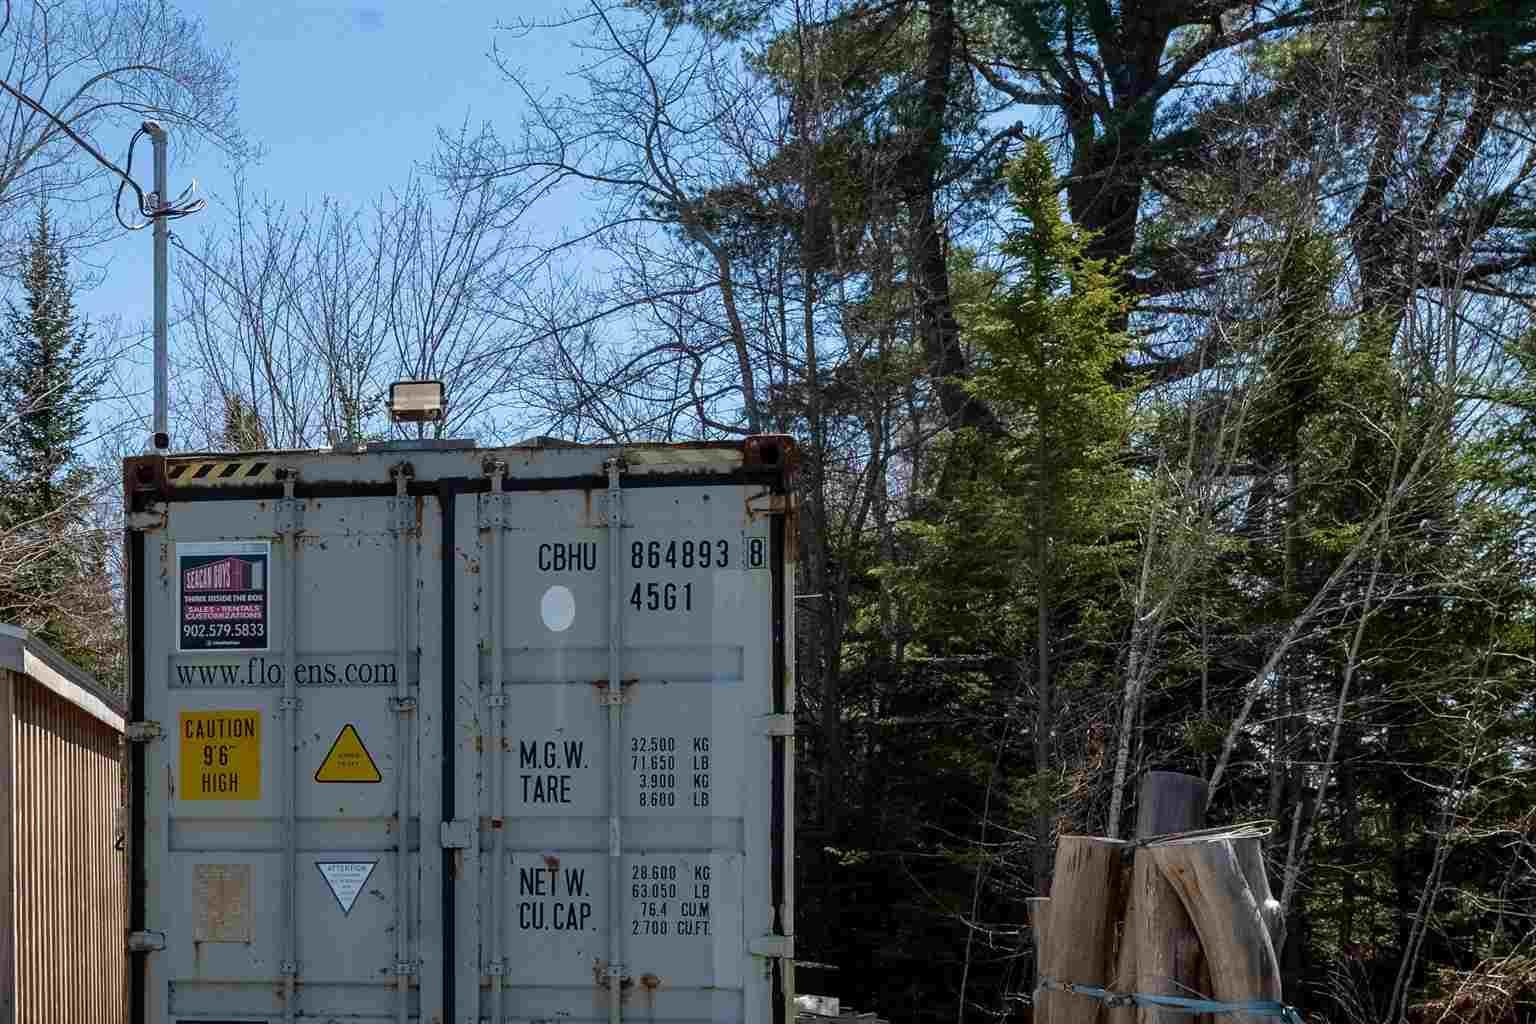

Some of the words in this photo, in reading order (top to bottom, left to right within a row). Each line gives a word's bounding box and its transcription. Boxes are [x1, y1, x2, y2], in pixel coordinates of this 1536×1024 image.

[538, 543, 597, 571] CBHU
[631, 539, 729, 569] 864893
[749, 538, 763, 567] 8
[630, 582, 693, 611] 45G1
[184, 623, 264, 638] 902.579.5833
[176, 656, 399, 686] www.floens.com
[185, 719, 255, 738] CAUTION
[520, 740, 589, 769] M.G.W.
[631, 737, 675, 752] 32.500
[693, 737, 710, 752] KG
[631, 755, 675, 771] 71.650
[693, 755, 710, 770] LB
[202, 773, 240, 793] HIGH
[520, 774, 572, 804] TARE
[639, 774, 675, 789] 3.900
[693, 774, 710, 789] KG
[639, 792, 675, 807] 8.600
[693, 792, 710, 807] LB
[520, 867, 559, 897] NET
[565, 867, 590, 897] W.
[631, 865, 677, 881] 28.600
[694, 865, 711, 881] KG
[631, 883, 677, 899] 63.050
[694, 883, 710, 899] LB
[641, 902, 667, 917] 76.4
[631, 920, 668, 936] 2.700
